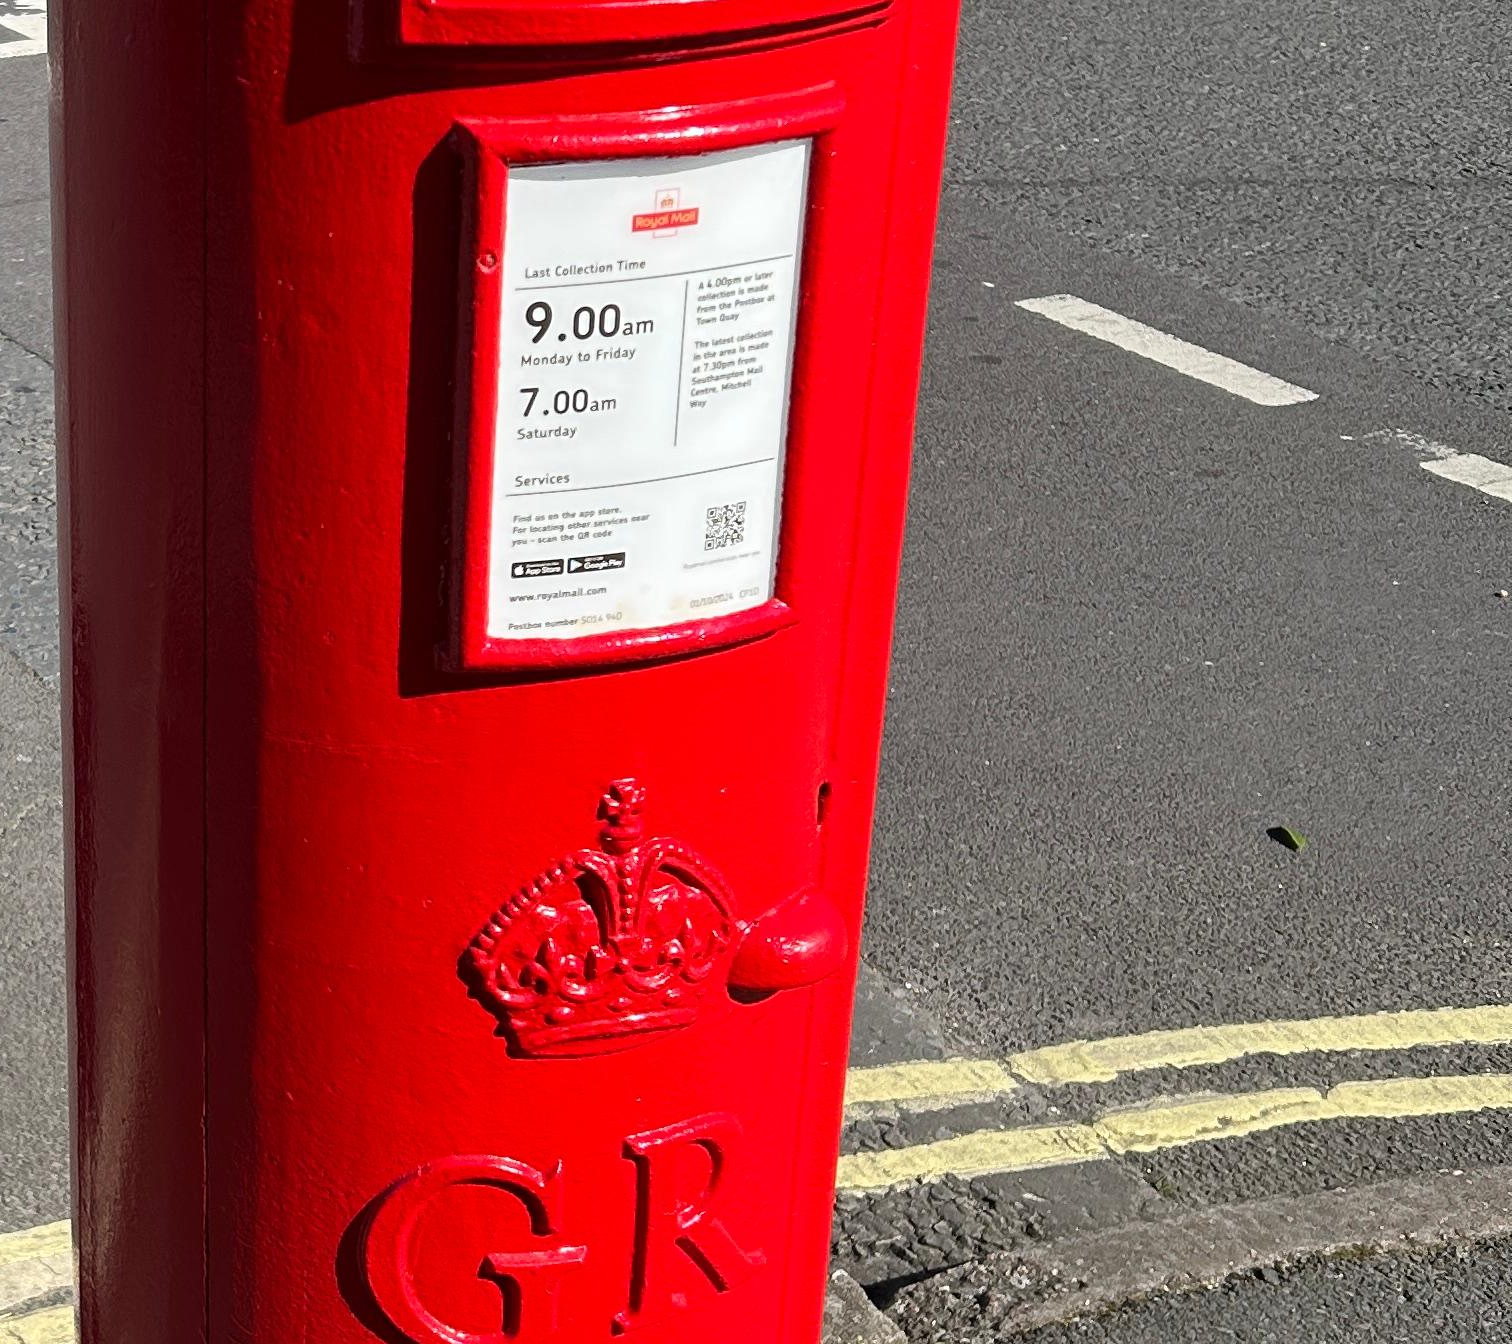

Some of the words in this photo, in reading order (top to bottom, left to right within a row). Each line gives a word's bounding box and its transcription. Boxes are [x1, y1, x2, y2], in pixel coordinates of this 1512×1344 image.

[636, 215, 669, 229] Royal
[669, 210, 696, 225] Mail
[524, 267, 551, 279] Last
[555, 262, 613, 277] Collection
[616, 259, 646, 271] Time
[755, 271, 774, 280] later
[697, 289, 735, 301] collection
[747, 284, 769, 293] made
[696, 304, 717, 313] from
[719, 302, 732, 310] the
[525, 301, 654, 344] 9.00am
[696, 316, 717, 325] Town
[695, 340, 709, 349] The
[712, 336, 734, 346] latest
[737, 329, 774, 342] collection
[520, 353, 573, 367] Monday
[577, 352, 591, 362] to
[596, 347, 636, 361] Friday
[703, 351, 717, 359] the
[719, 348, 736, 356] area
[519, 387, 616, 417] 7.00am
[517, 426, 577, 440] Saturday
[514, 473, 570, 488] Services
[513, 514, 532, 523] Find
[579, 509, 595, 518] app
[513, 526, 526, 534] For
[530, 523, 564, 533] locating
[567, 521, 591, 530] other
[593, 518, 628, 528] services
[511, 539, 527, 547] you
[538, 536, 557, 544] scan
[577, 532, 589, 540] QR
[593, 529, 612, 538] code
[509, 587, 607, 602] www.royalmail.com
